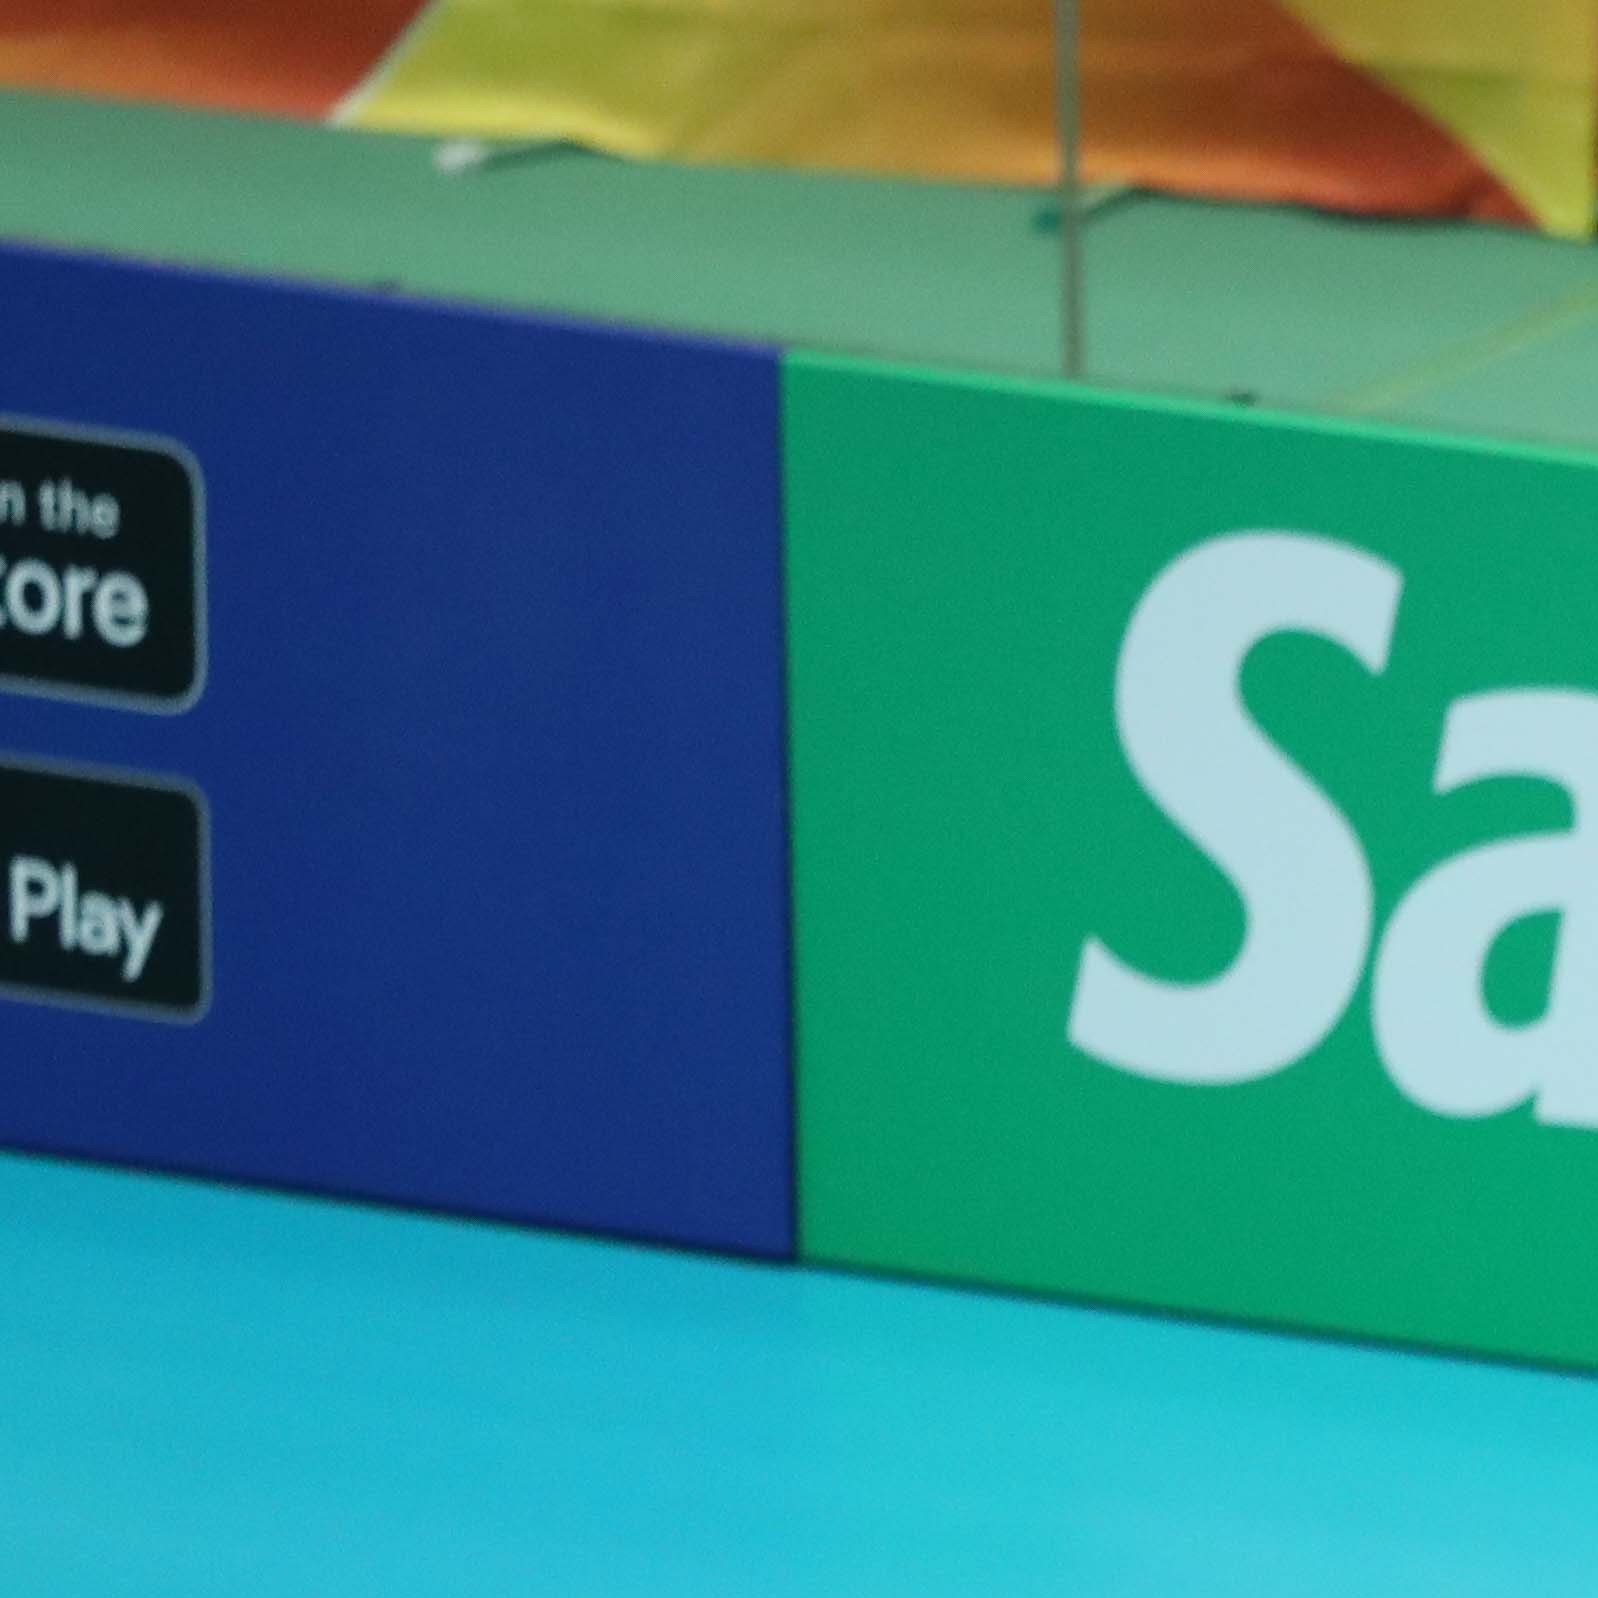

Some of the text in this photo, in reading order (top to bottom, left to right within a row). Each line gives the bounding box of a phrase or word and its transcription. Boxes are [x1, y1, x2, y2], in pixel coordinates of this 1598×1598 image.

[38, 478, 120, 539] the
[0, 556, 149, 647] ore
[9, 856, 163, 982] Play
